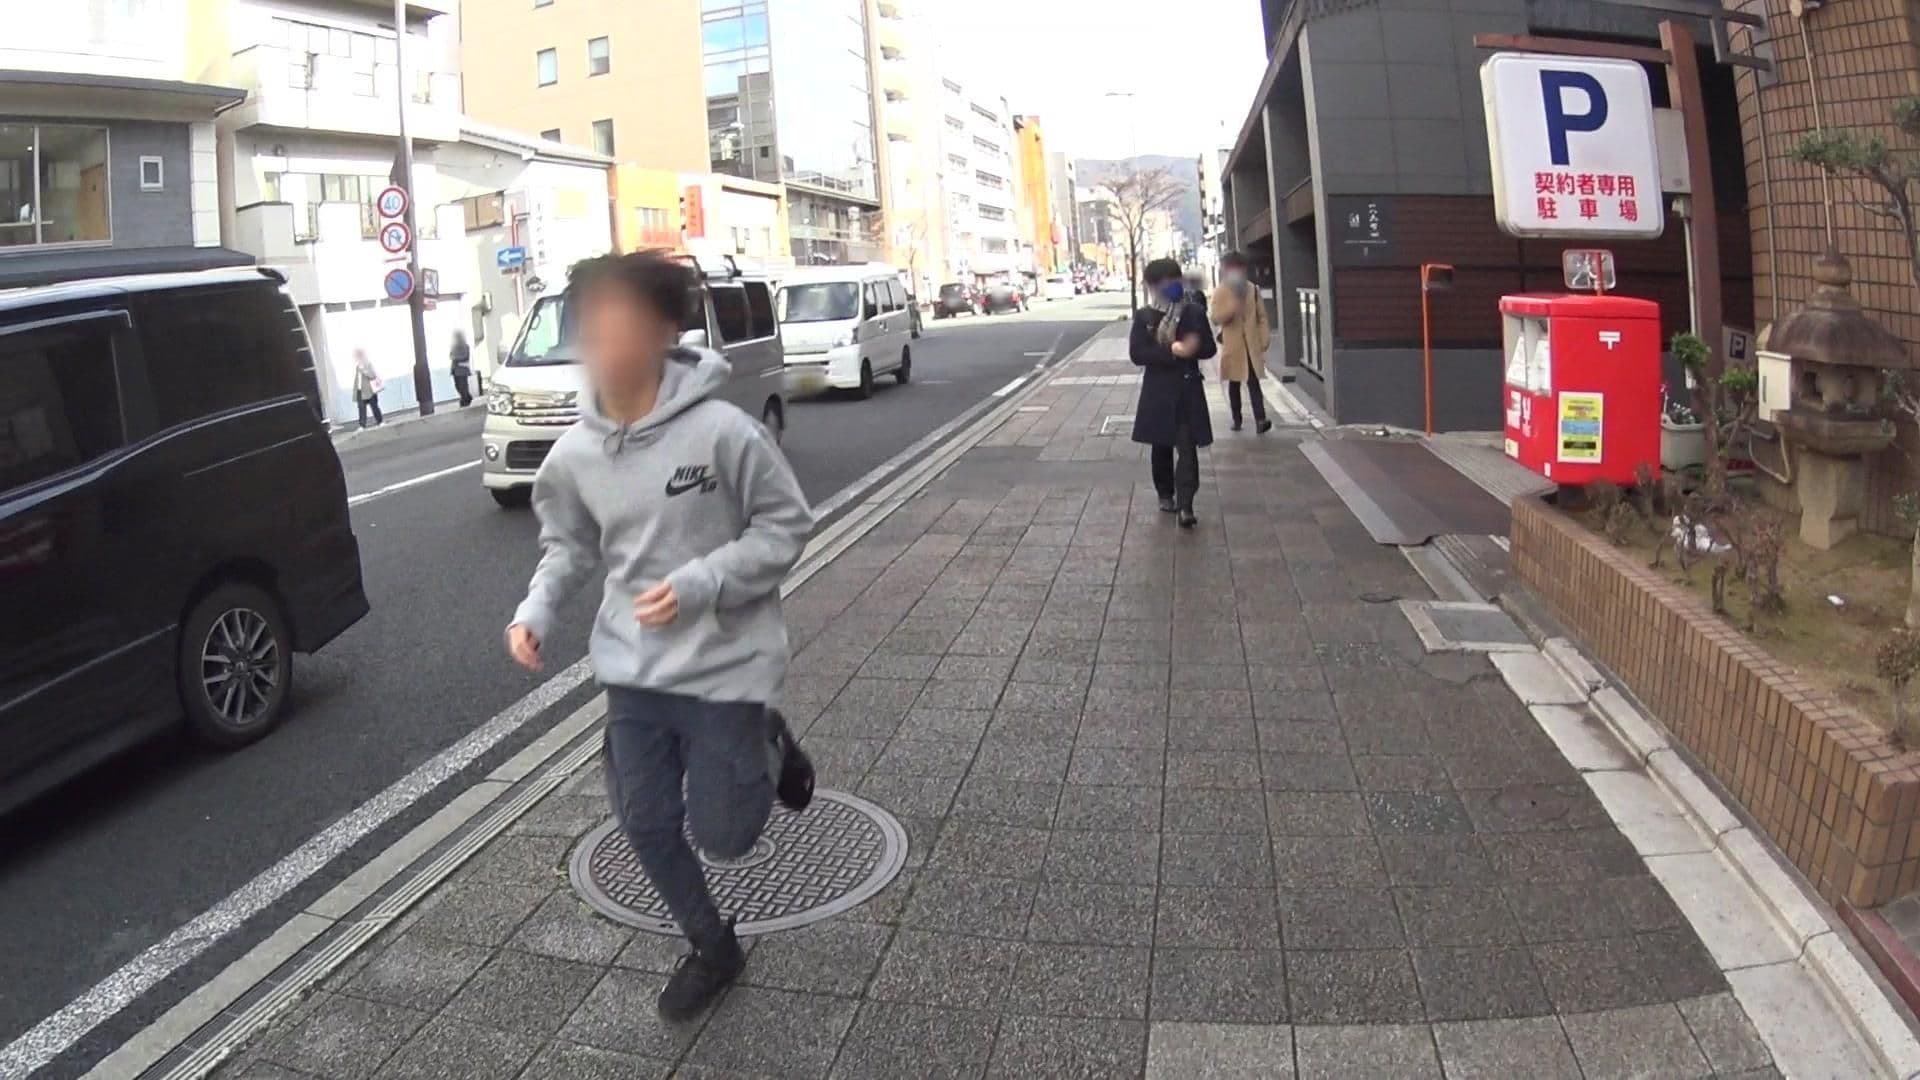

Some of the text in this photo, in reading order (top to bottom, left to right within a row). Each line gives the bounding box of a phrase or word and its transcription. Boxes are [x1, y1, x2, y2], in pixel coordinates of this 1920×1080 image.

[1539, 69, 1609, 166] P
[1535, 172, 1636, 197] 契約者専用
[384, 195, 400, 210] 40
[1537, 197, 1638, 221] 駐車場
[1732, 334, 1744, 356] P
[673, 464, 709, 481] NIKE
